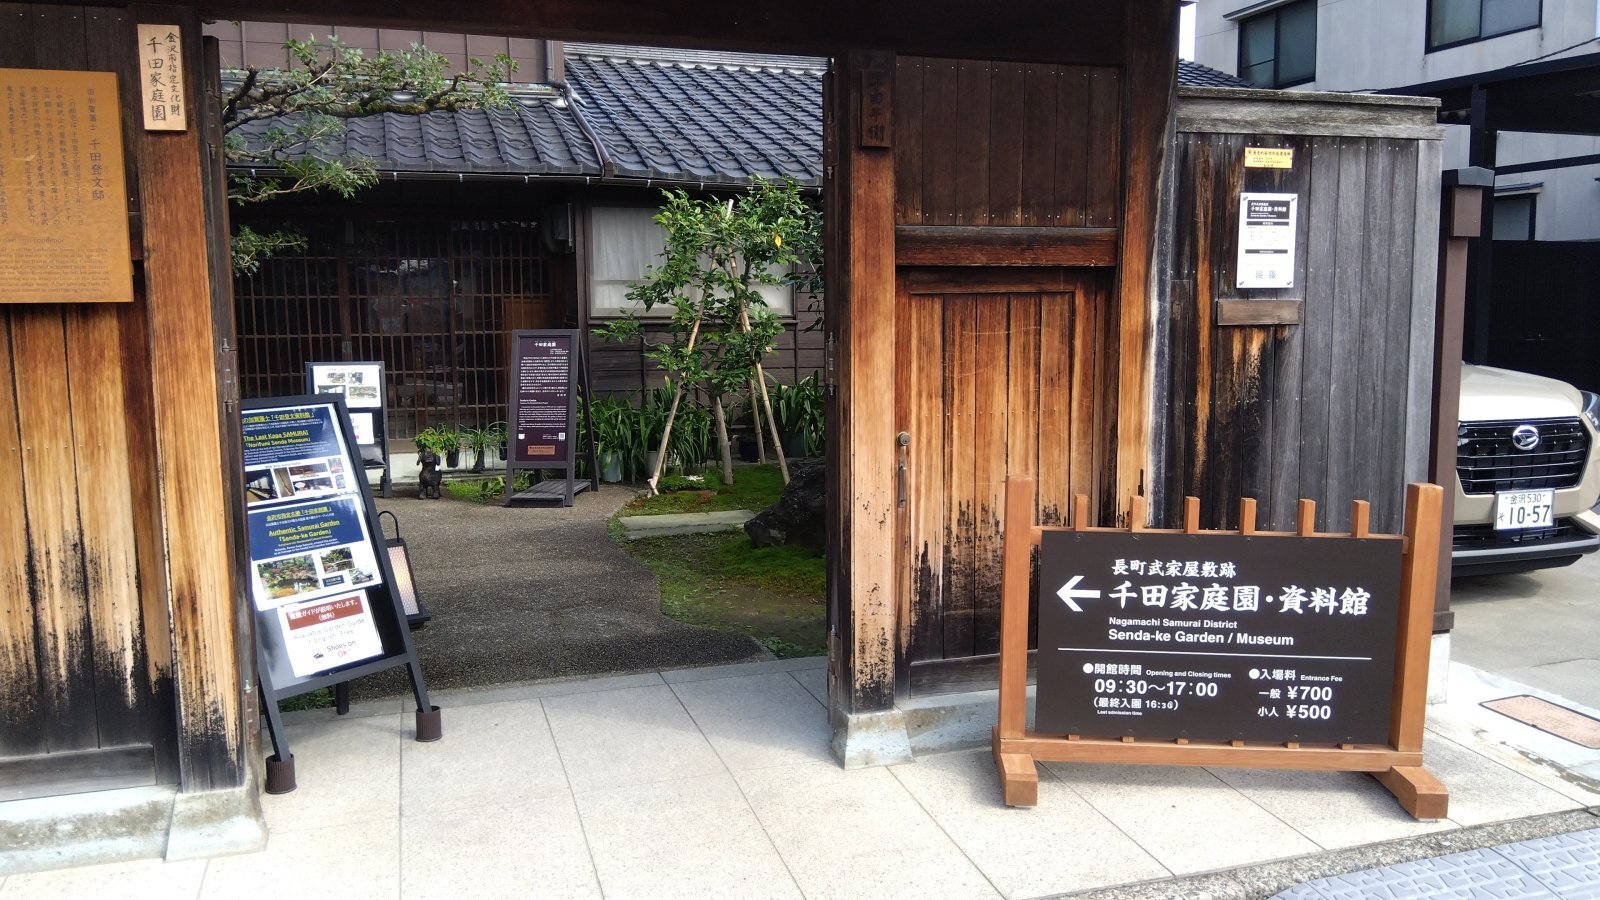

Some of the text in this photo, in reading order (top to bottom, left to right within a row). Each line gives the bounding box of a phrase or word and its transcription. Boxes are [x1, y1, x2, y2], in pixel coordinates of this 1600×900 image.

[147, 36, 167, 121] 千田家庭園
[165, 32, 181, 116] 金沢市指定文化財
[89, 138, 105, 201] 千田登文邸
[283, 429, 309, 437] SAMURAI
[1510, 493, 1541, 504] 金沢530
[1510, 505, 1550, 525] 10-57
[269, 527, 296, 537] Authentic
[297, 523, 320, 532] Samurai
[320, 520, 340, 528] Garden
[1111, 558, 1236, 579] 長町武家屋敷跡
[1108, 580, 1371, 616] 千田家庭園・資料館
[1109, 616, 1237, 629] Nagamachi Samurai District
[1109, 628, 1294, 646] Senda-ke Garden / Museum
[327, 643, 347, 652] Shoes
[1094, 663, 1142, 675] 開館時間
[1146, 669, 1174, 678] Opening
[1260, 668, 1296, 680] 入場料
[1259, 686, 1333, 700] 一般 ¥700
[1257, 704, 1331, 719] 小人 ¥500
